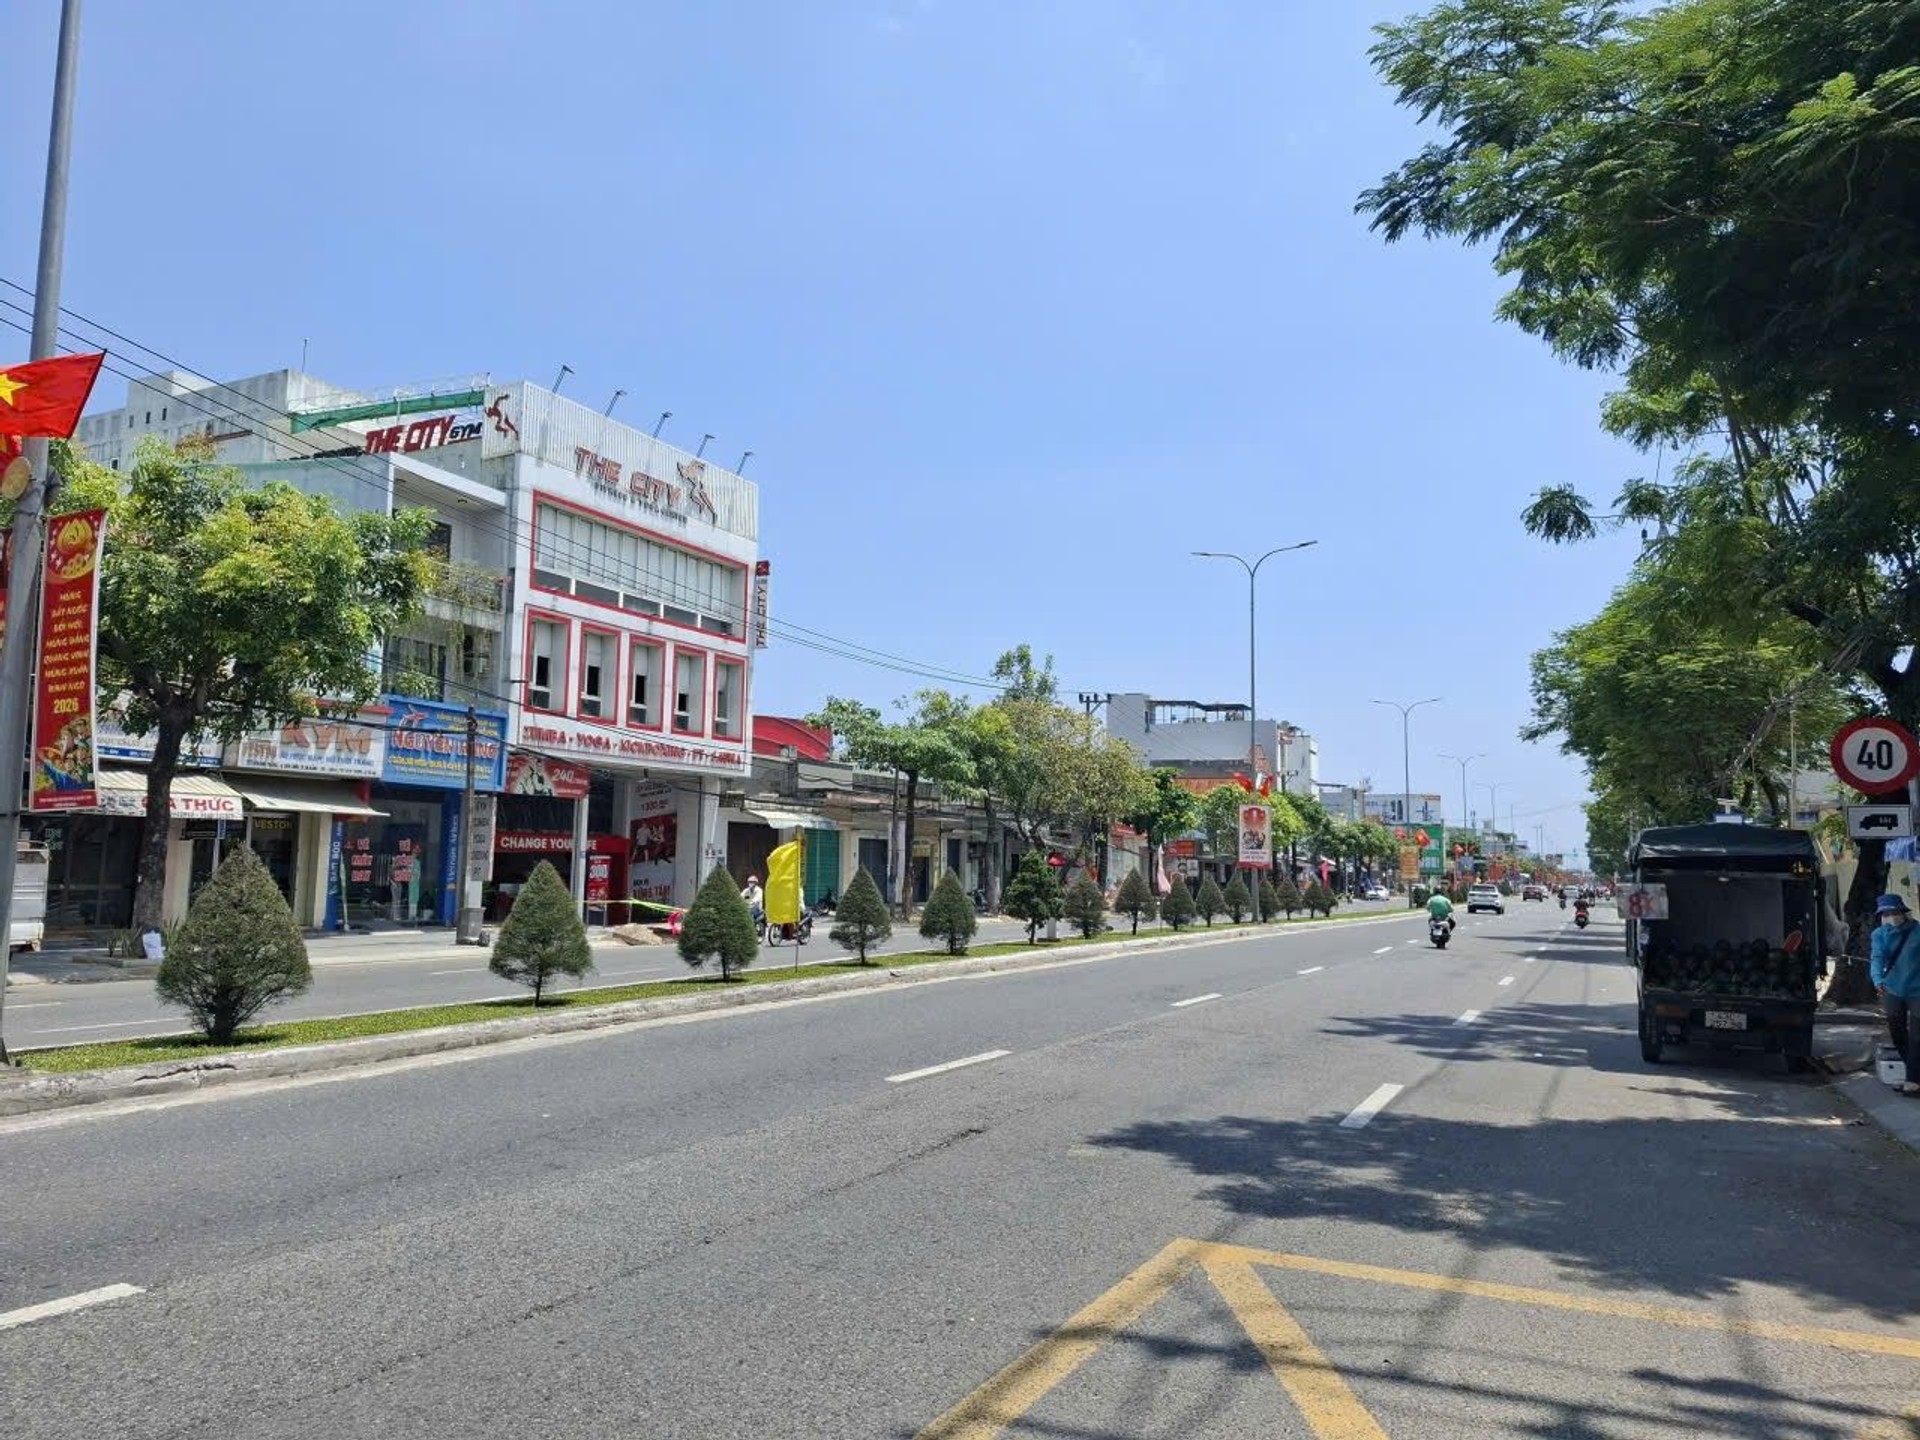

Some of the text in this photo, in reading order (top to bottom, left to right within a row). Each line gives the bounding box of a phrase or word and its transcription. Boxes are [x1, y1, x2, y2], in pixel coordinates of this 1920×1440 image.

[366, 415, 482, 455] THE CITY GYM
[575, 446, 682, 505] THE CITY
[757, 586, 767, 618] CITY
[756, 621, 766, 648] THE
[54, 698, 79, 714] 2026
[457, 740, 498, 759] HNG
[577, 732, 612, 751] YOGA
[1857, 740, 1893, 770] 40
[181, 795, 234, 812] THỨC
[501, 836, 547, 849] CHANGE
[550, 838, 577, 850] YOU
